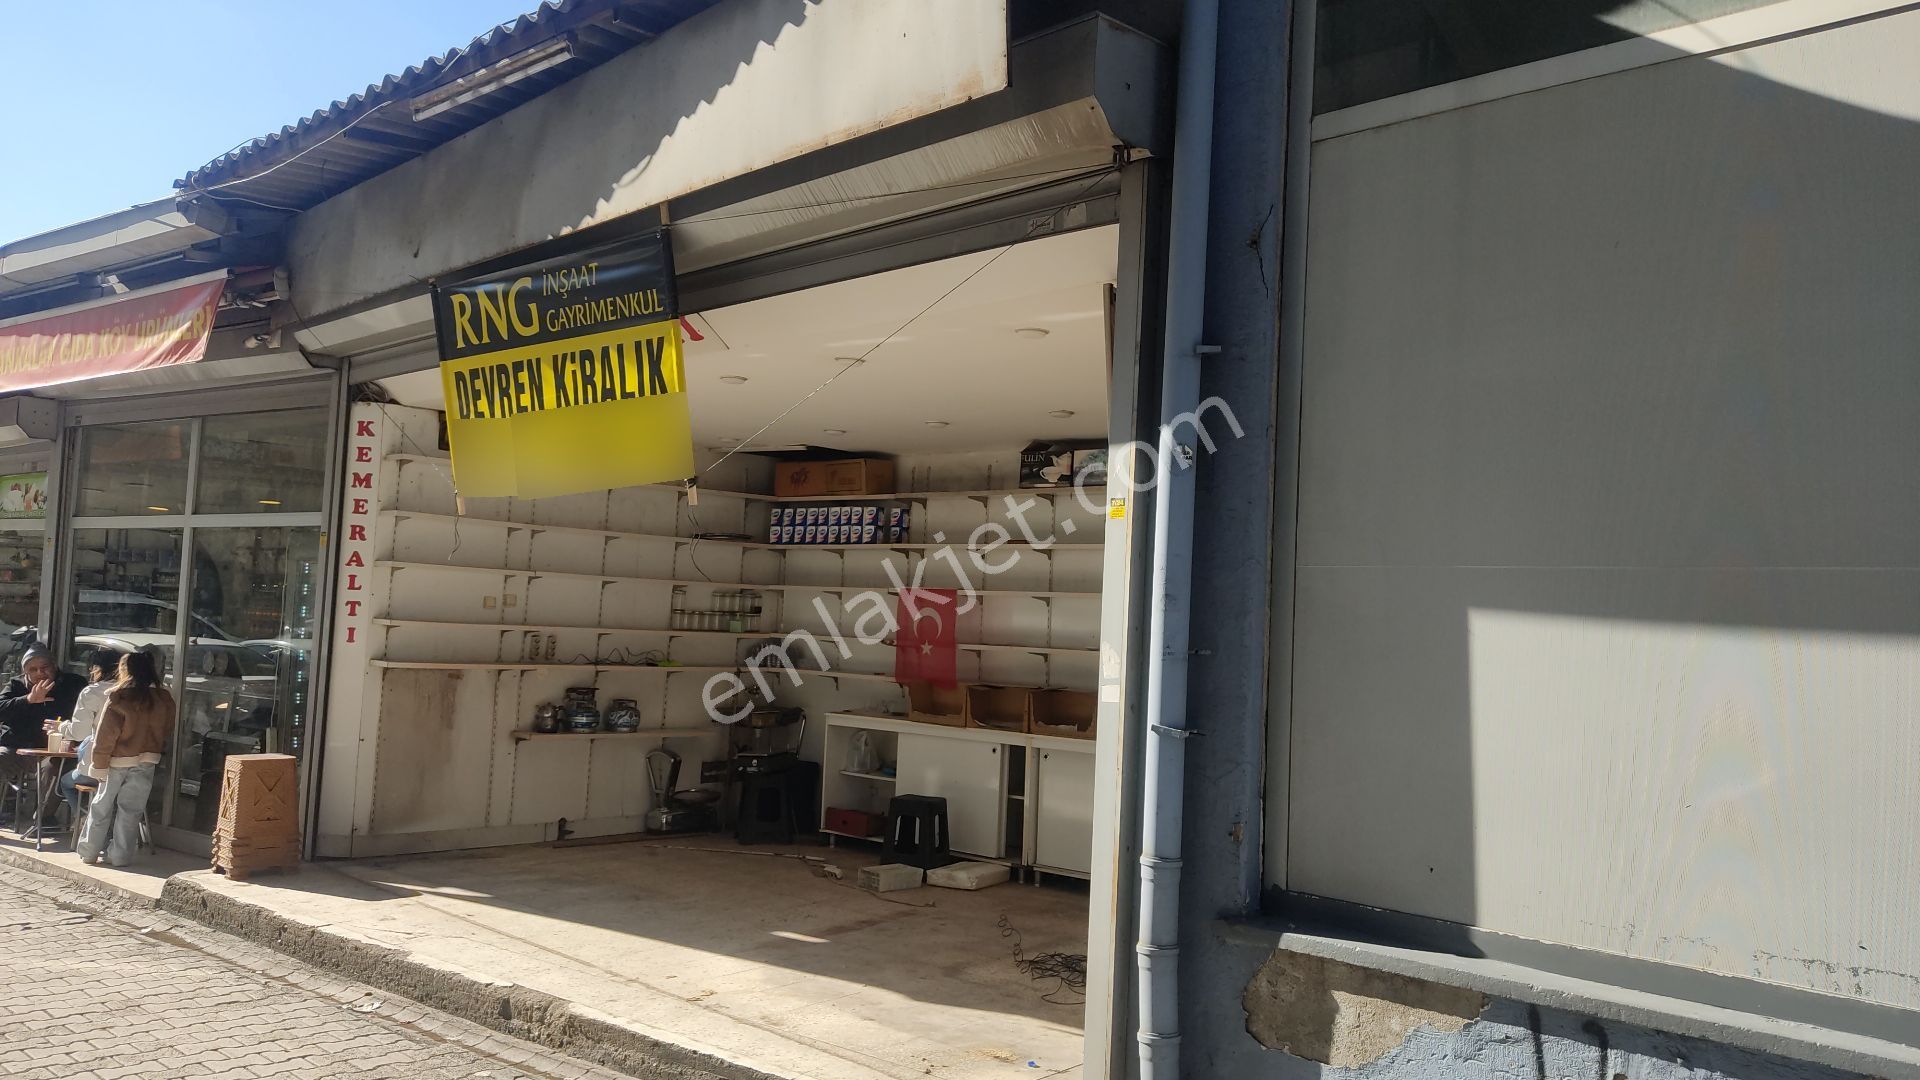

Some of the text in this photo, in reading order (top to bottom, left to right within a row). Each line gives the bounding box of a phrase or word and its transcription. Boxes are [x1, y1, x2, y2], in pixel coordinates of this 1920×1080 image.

[542, 262, 599, 299] İNŞAAT
[546, 288, 664, 332] GAYRİMENKUL
[450, 277, 540, 349] RNG
[454, 357, 545, 420] DEVREN
[345, 420, 376, 643] KEMERALTI
